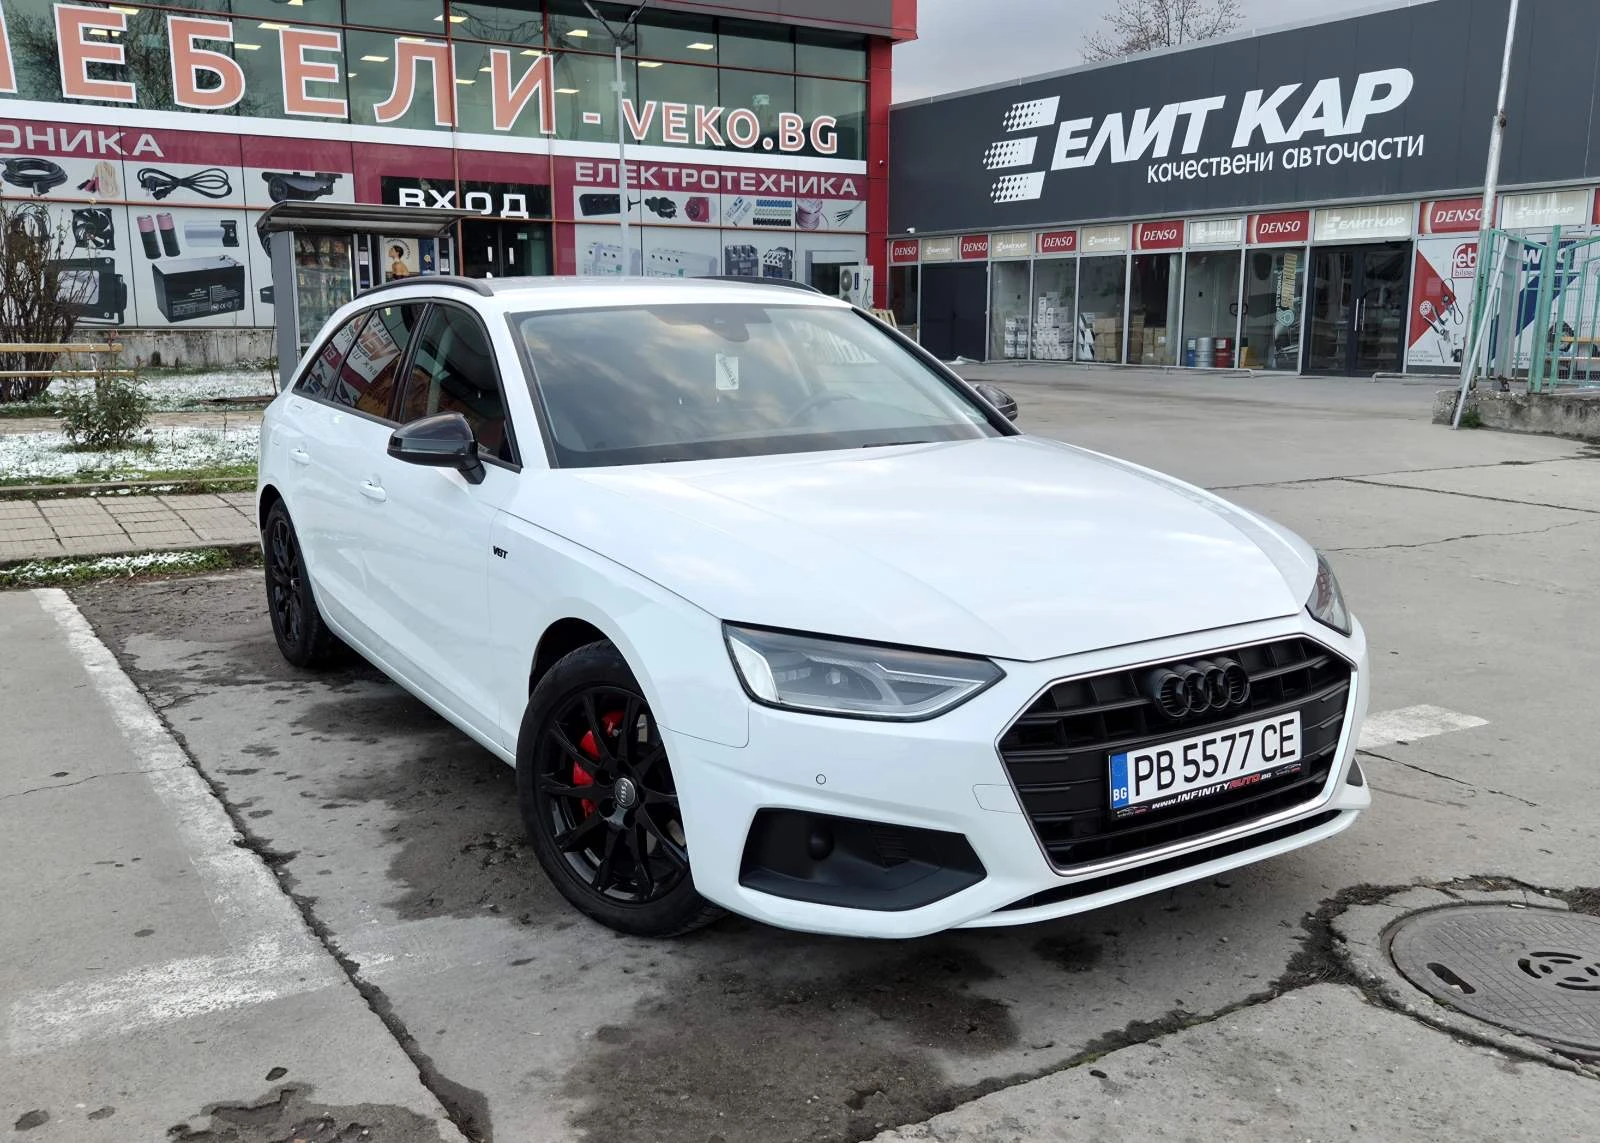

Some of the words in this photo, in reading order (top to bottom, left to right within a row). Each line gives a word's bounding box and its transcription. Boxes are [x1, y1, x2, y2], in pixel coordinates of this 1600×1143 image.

[621, 99, 838, 154] VEKO.BG
[1050, 95, 1226, 171] ЕЛИТ
[1231, 67, 1414, 149] КАР
[1147, 149, 1274, 184] качествени
[1282, 134, 1425, 169] авточасти
[575, 161, 859, 197] ЕЛЕКТРОТЕХНИКА
[398, 187, 530, 219] ВХОД
[1143, 229, 1177, 241] DENSO
[1259, 220, 1301, 234] DENSO
[894, 246, 917, 256] DENSO
[962, 242, 988, 252] DENSO
[1043, 236, 1073, 248] DENSO
[1134, 749, 1176, 797] PB
[1183, 728, 1254, 784] 5577
[1260, 718, 1296, 762] CE
[1113, 786, 1128, 801] BG
